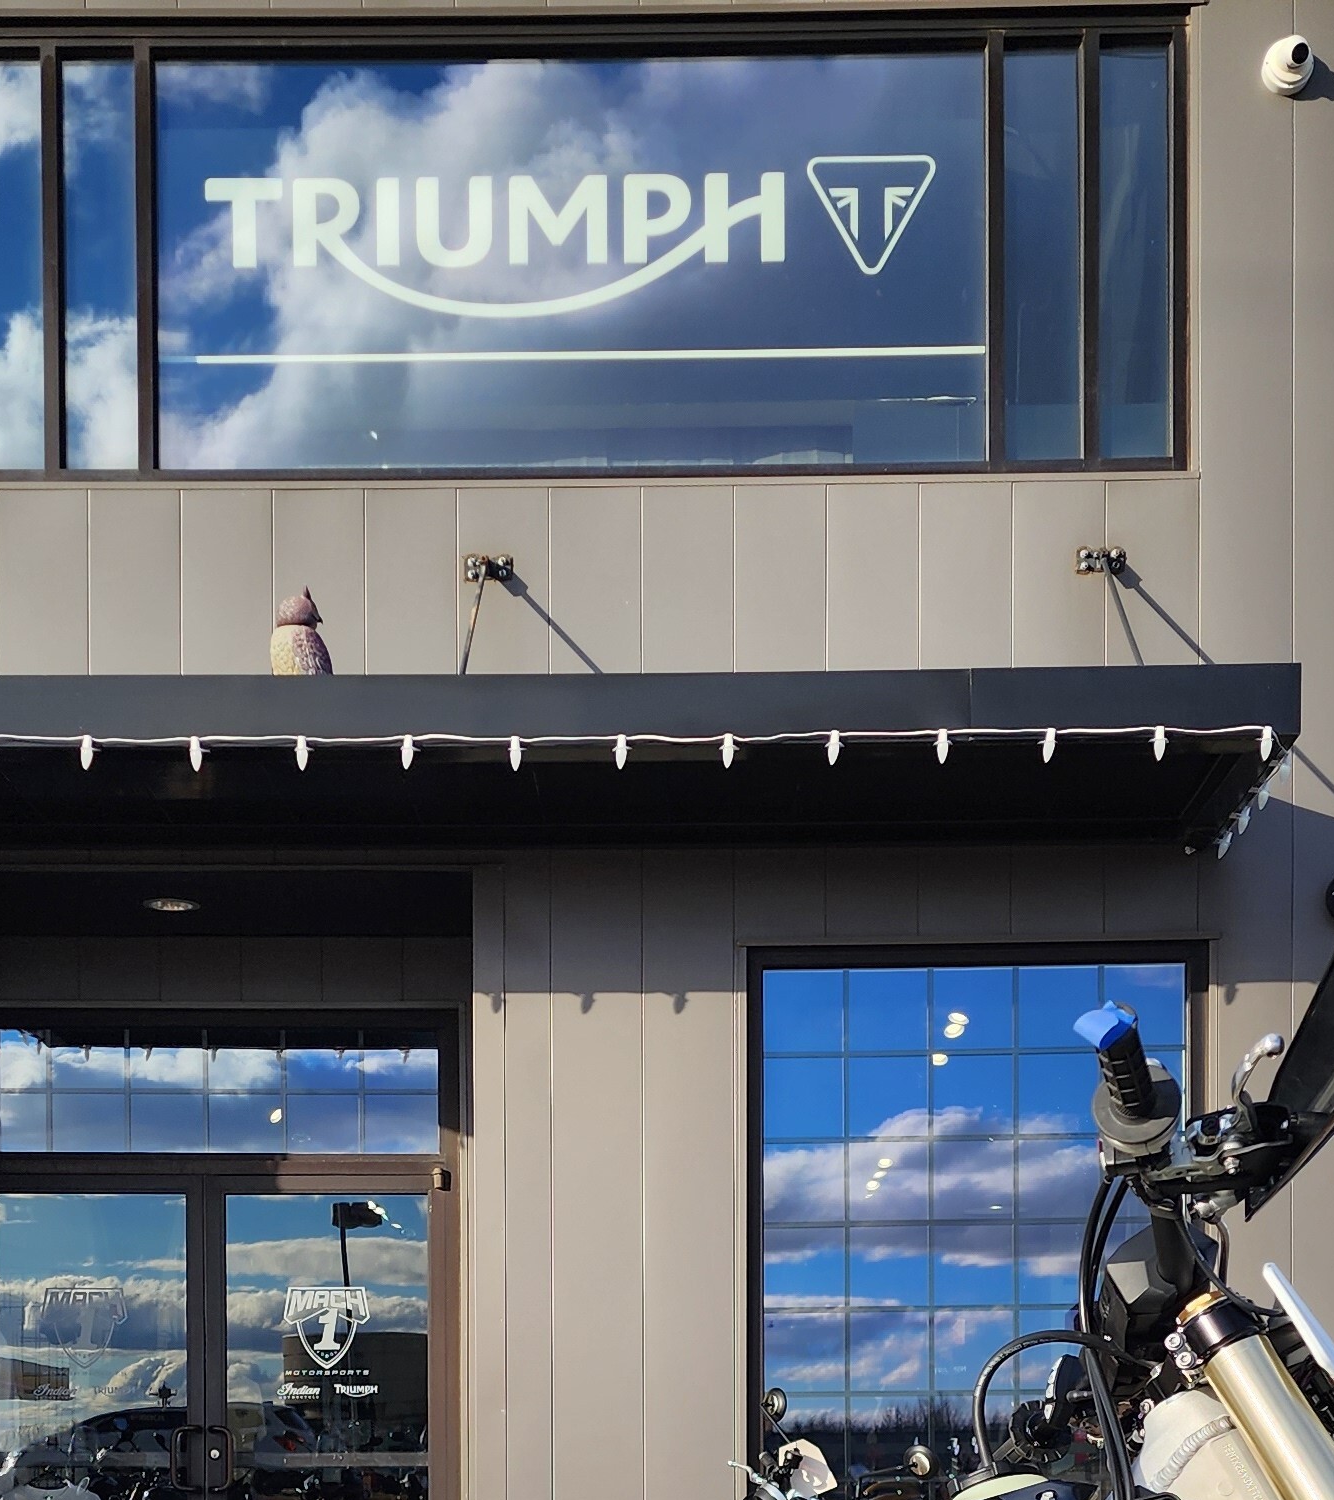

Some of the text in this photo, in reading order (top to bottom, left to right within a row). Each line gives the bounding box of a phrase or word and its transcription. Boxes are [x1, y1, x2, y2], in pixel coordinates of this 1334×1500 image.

[204, 172, 785, 318] TRIUMPH
[287, 1290, 366, 1317] MACH
[313, 1307, 341, 1351] 1
[284, 1369, 370, 1377] MOTORSPORTS
[276, 1383, 321, 1397] Indian
[333, 1383, 379, 1398] TRIUMPH
